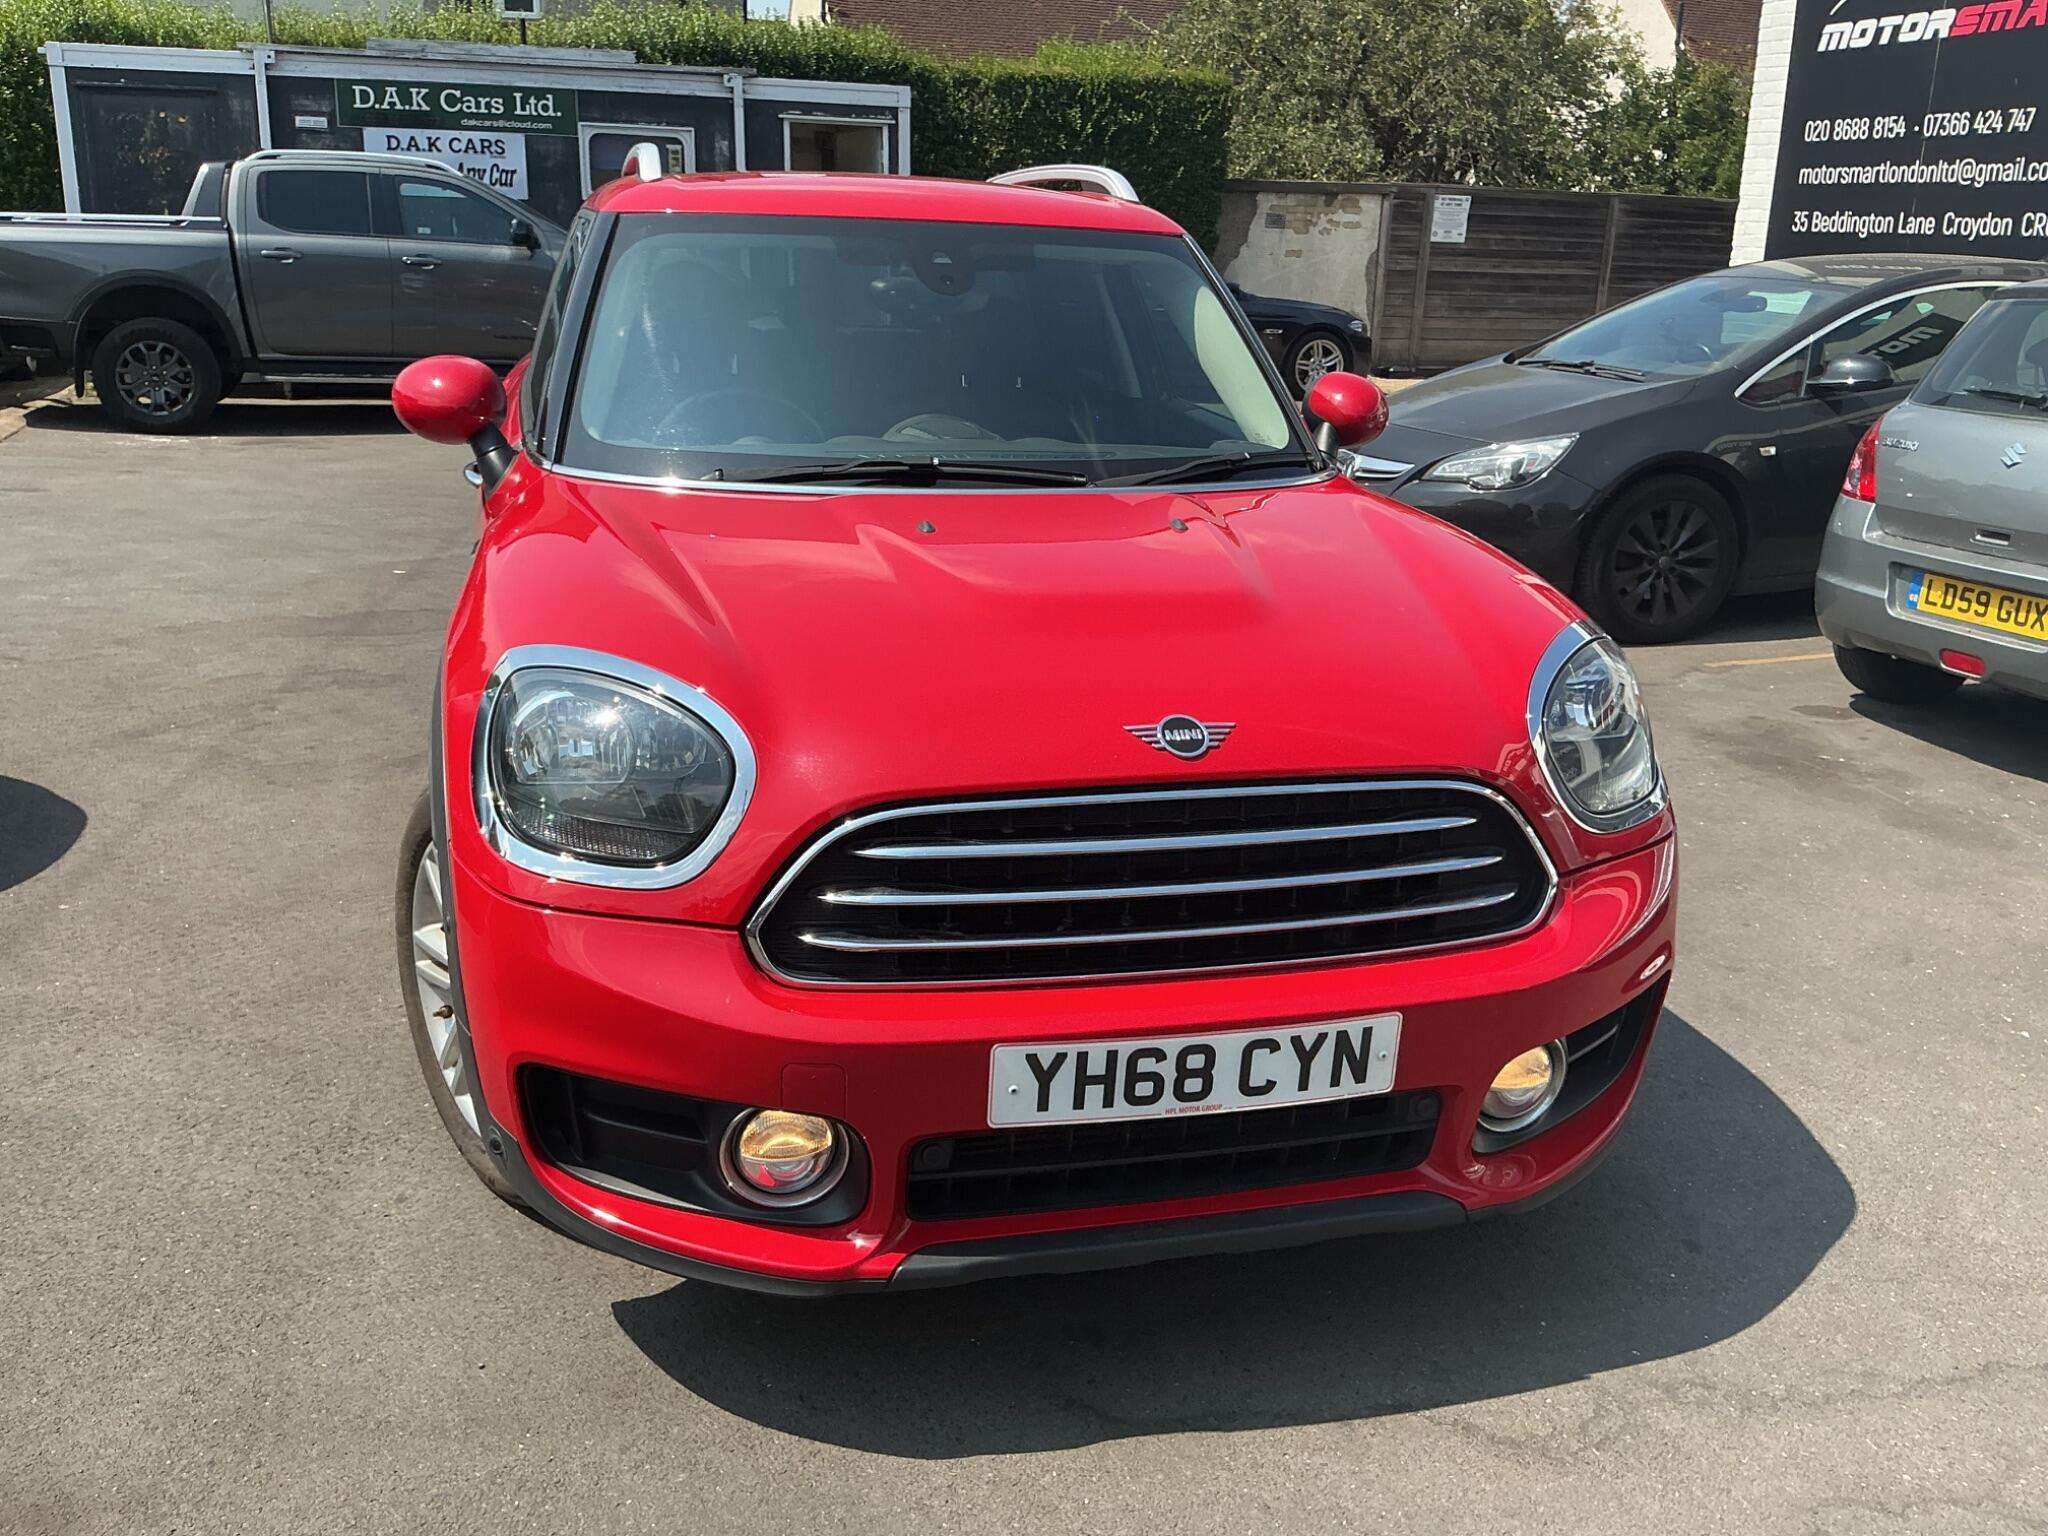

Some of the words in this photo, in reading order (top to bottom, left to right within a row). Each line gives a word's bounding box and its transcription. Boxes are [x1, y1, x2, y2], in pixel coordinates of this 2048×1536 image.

[352, 85, 430, 111] D.A.K
[439, 89, 504, 114] Cars
[513, 92, 562, 117] Ltd.
[1804, 119, 1831, 142] 020
[1832, 116, 1870, 140] 8688
[1873, 115, 1906, 138] 8154
[1923, 111, 1971, 137] 07366
[1973, 109, 2003, 134] 424
[2007, 107, 2037, 132] 747
[386, 134, 442, 153] D.A.K
[448, 137, 506, 156] CARS
[489, 163, 517, 187] Car
[1791, 210, 1810, 232] 35
[1811, 210, 1894, 238] Beddington
[1897, 211, 1935, 235] Lane
[1942, 211, 2013, 241] Croydon
[2021, 211, 2048, 237] CR
[1924, 578, 1991, 618] LD59
[1996, 595, 2048, 632] GUX
[1163, 728, 1203, 741] MINI
[1024, 1043, 1217, 1113] YH68
[1237, 1026, 1374, 1097] CYN
